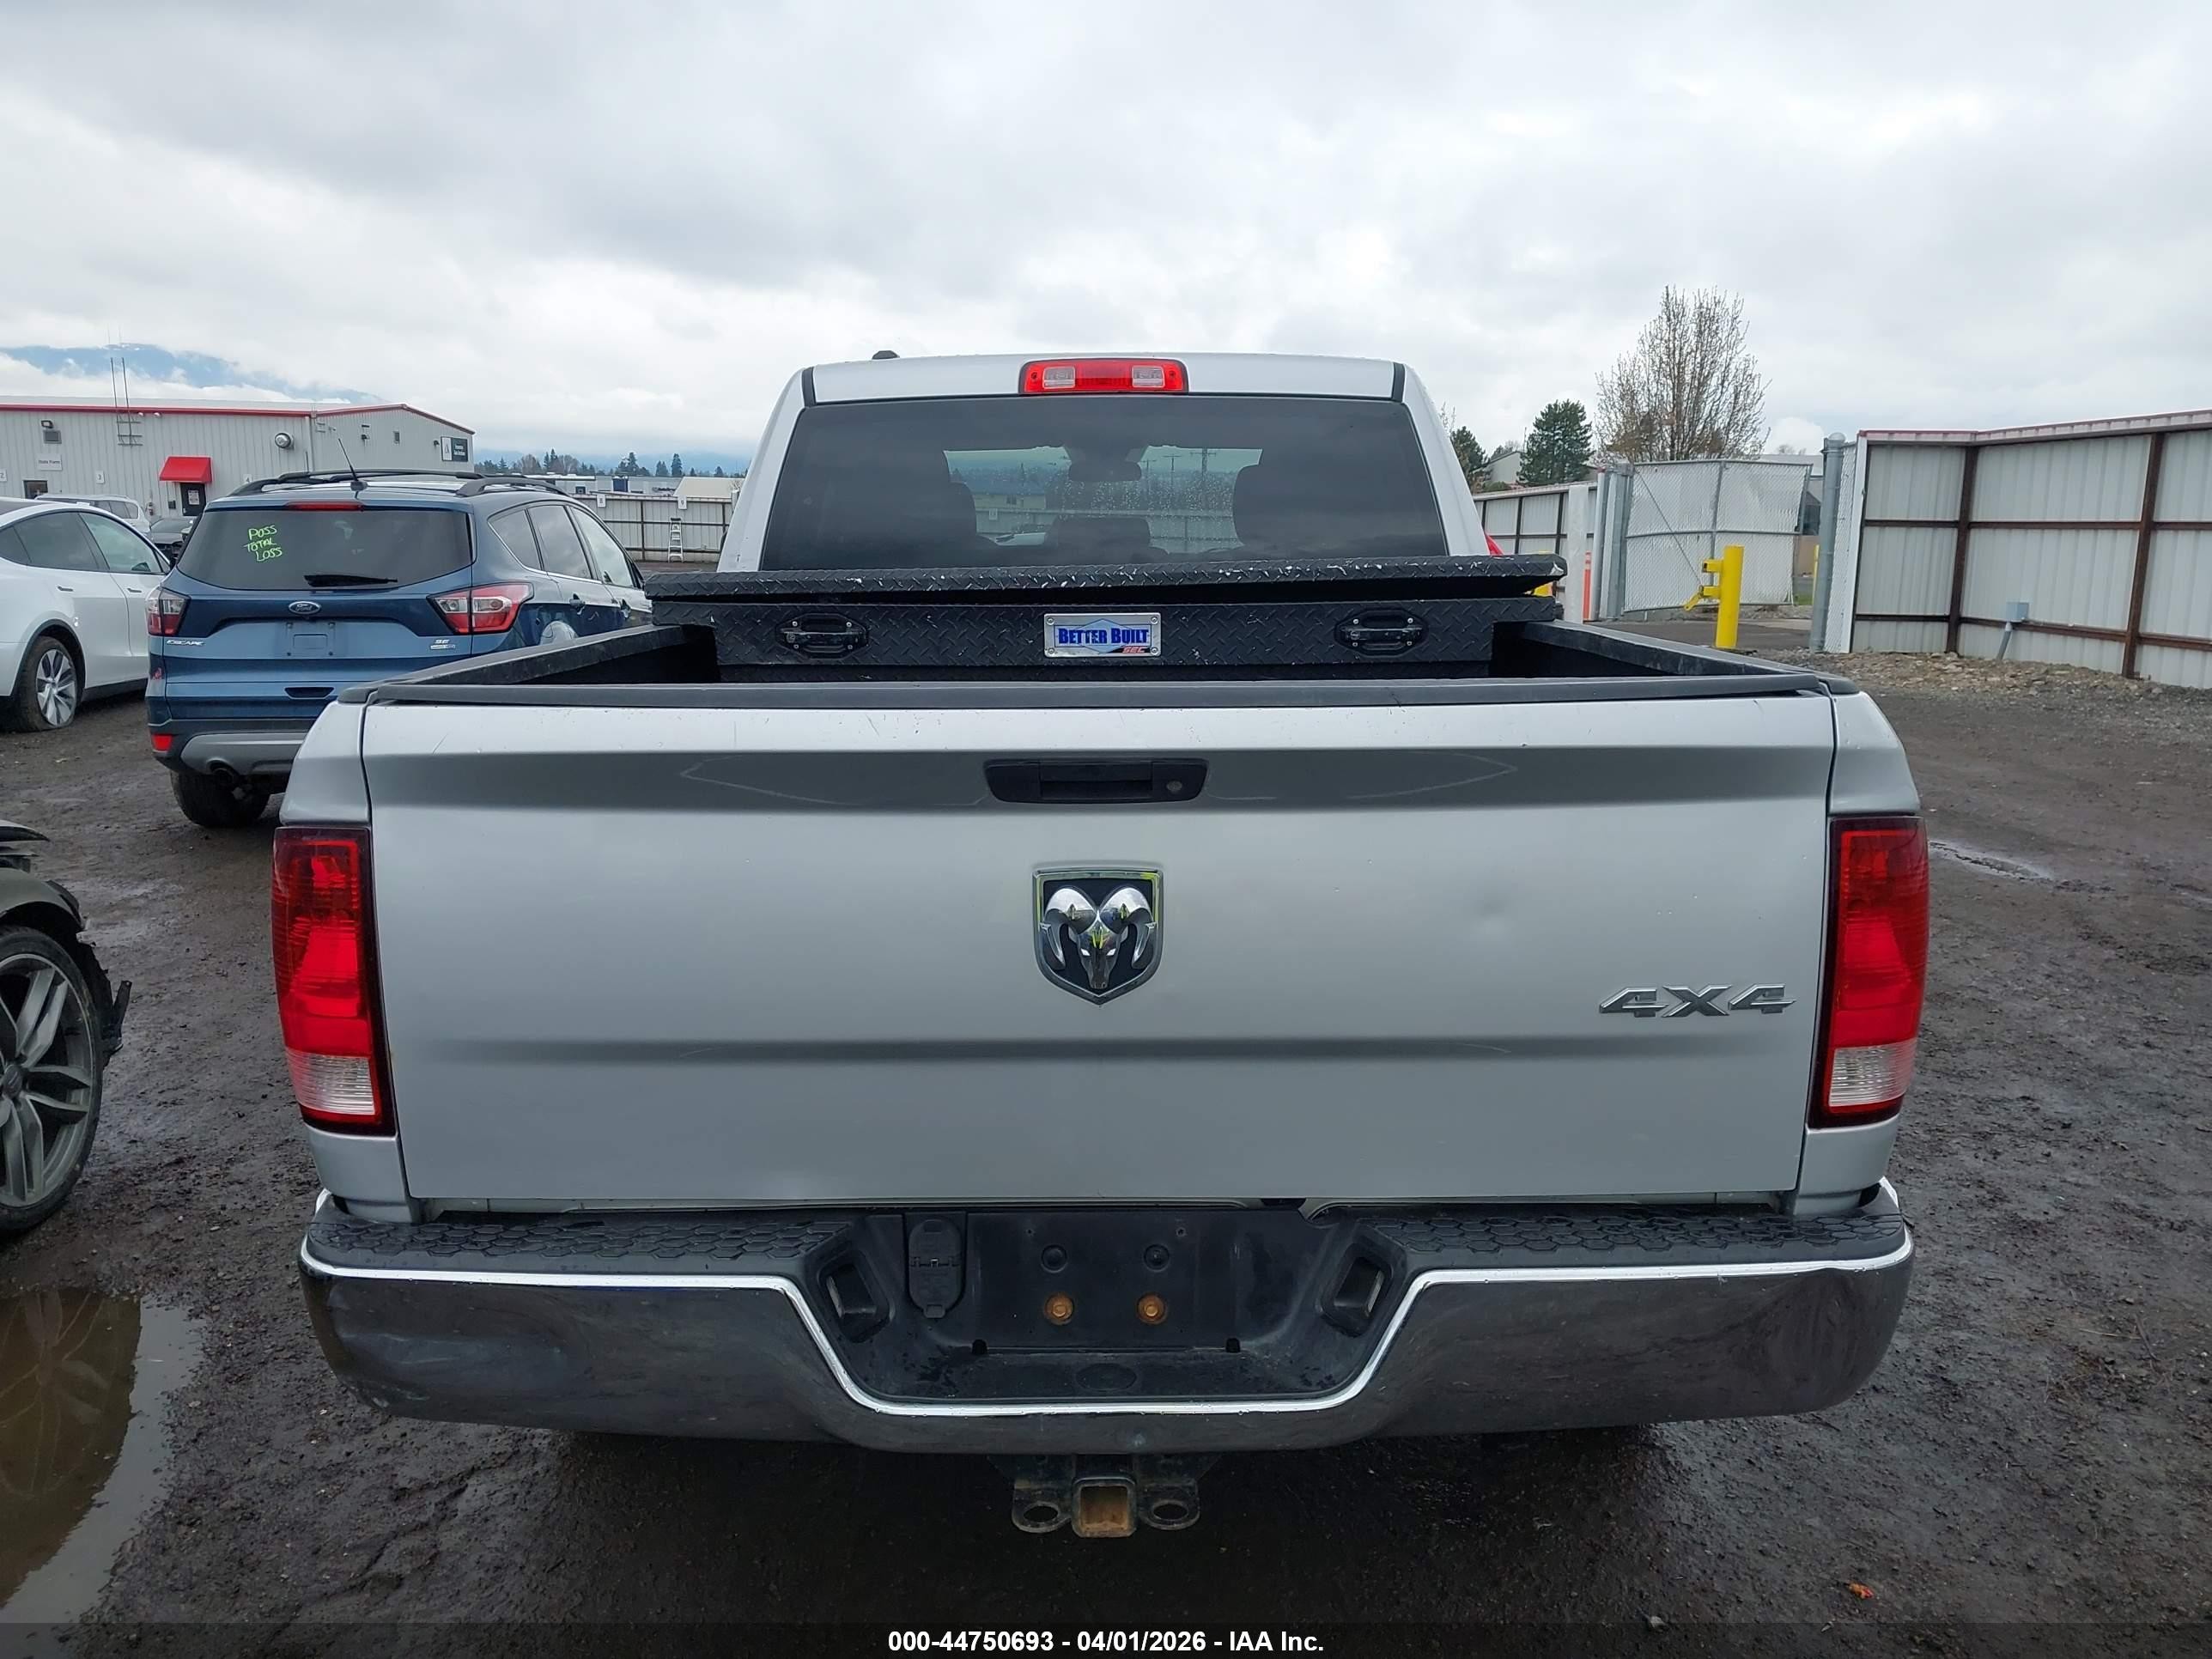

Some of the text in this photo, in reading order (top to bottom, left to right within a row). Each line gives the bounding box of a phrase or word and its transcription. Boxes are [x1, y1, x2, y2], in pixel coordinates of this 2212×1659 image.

[249, 525, 277, 541] POSS
[255, 547, 283, 562] LOSS
[1600, 985, 1796, 1018] 4X4
